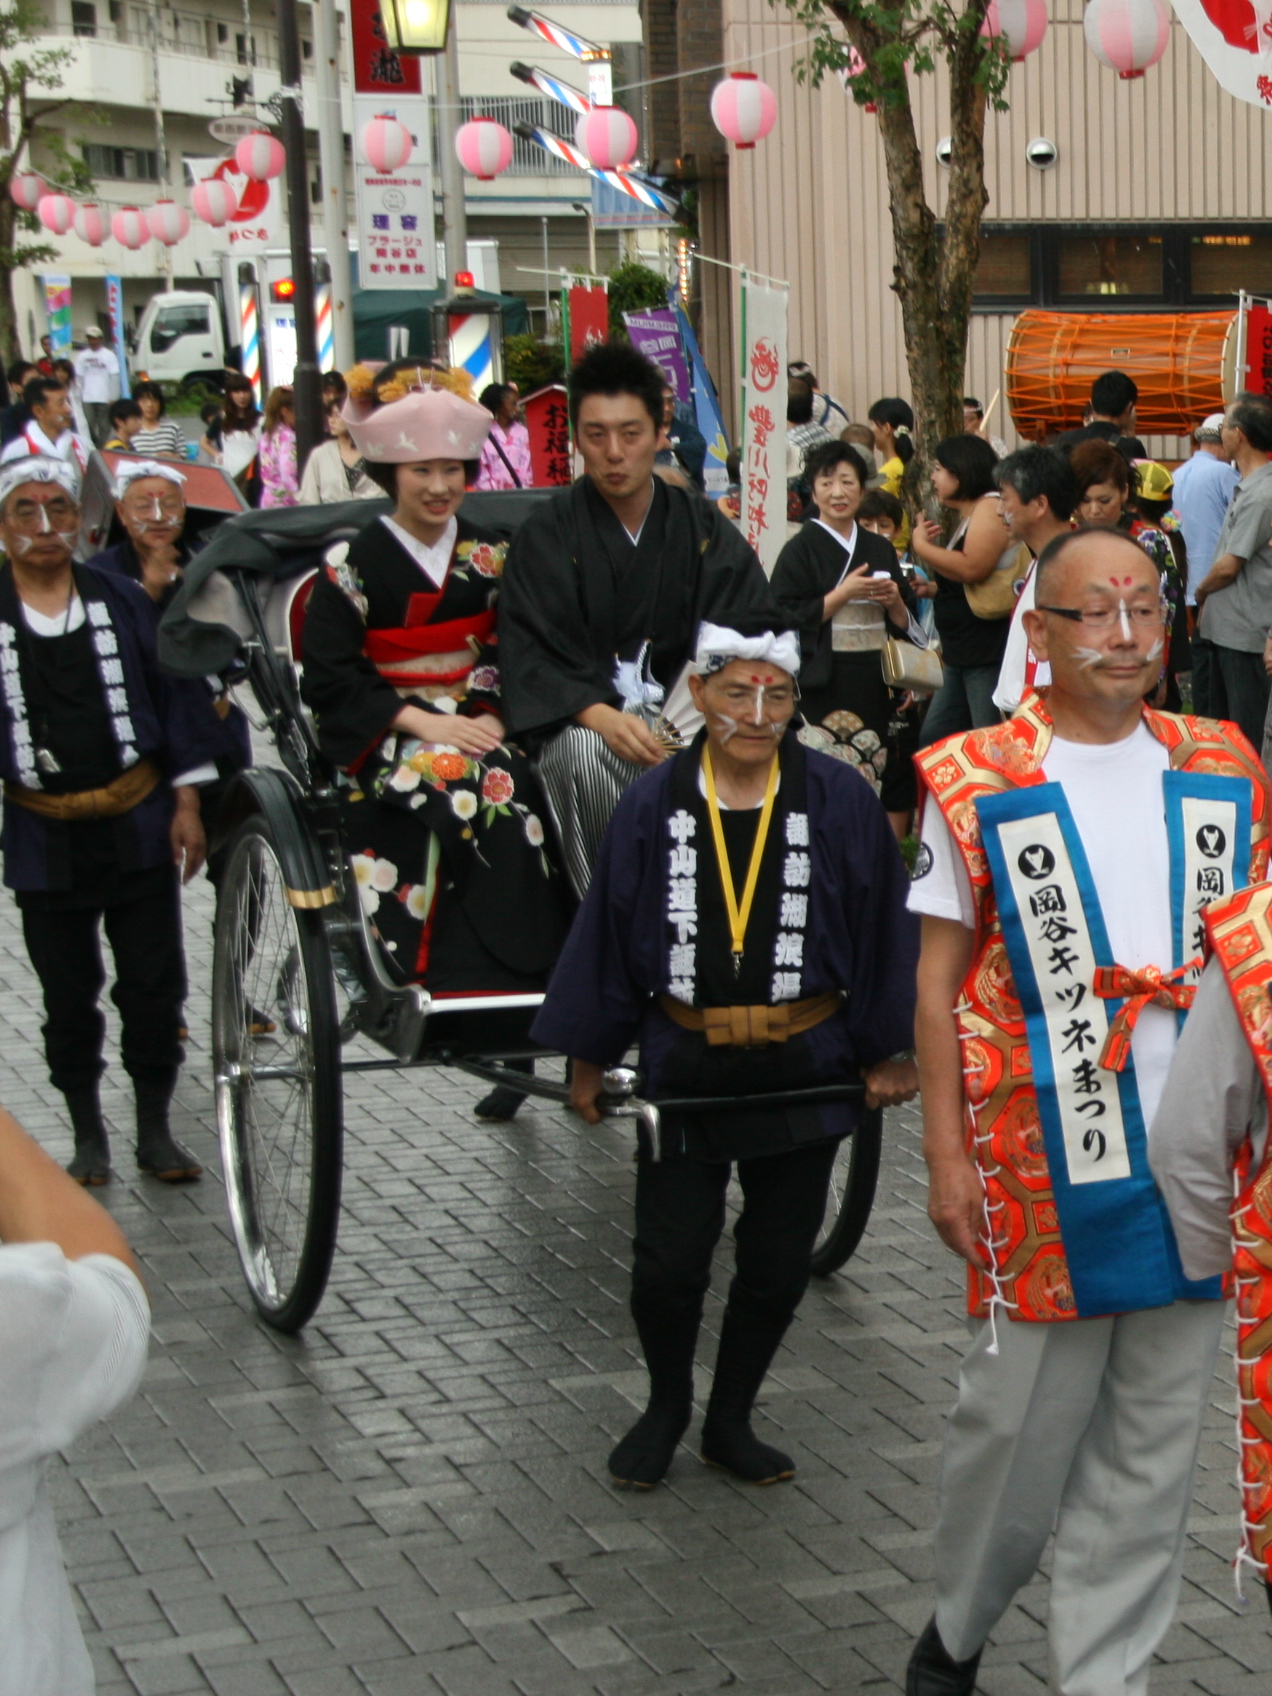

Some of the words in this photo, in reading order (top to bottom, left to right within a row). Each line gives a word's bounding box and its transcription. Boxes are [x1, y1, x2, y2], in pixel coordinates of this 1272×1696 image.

[1029, 884, 1106, 1162] 岡谷キツネまつり
